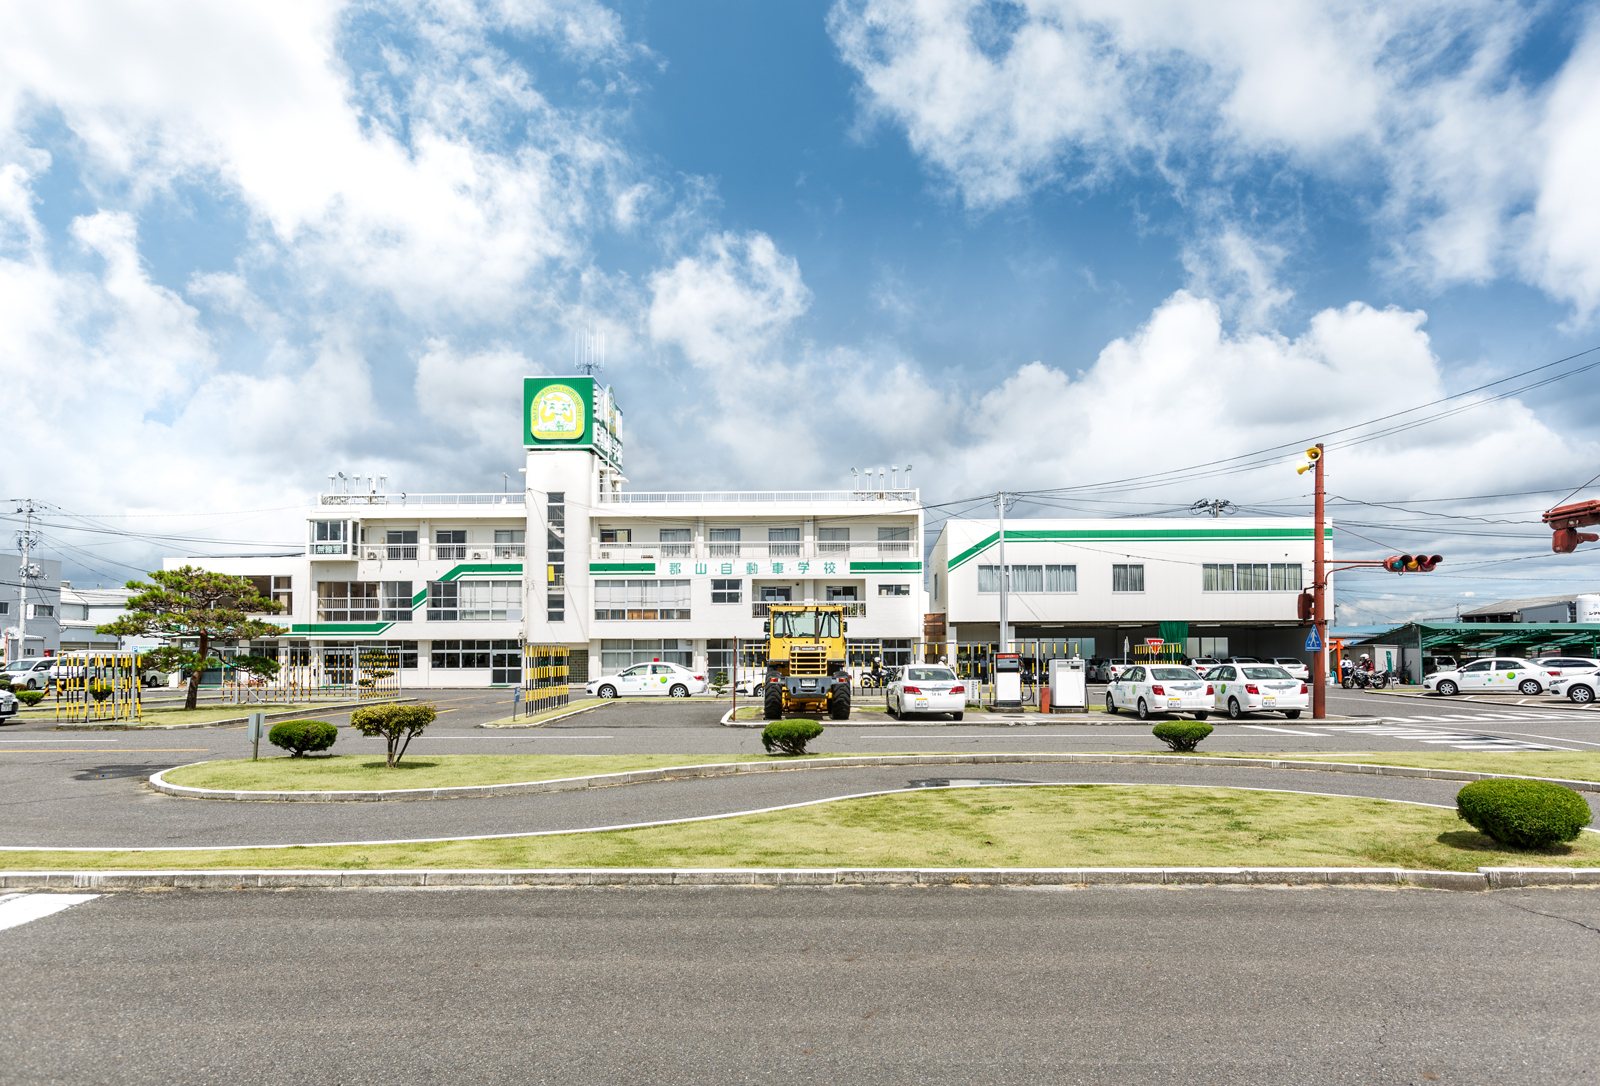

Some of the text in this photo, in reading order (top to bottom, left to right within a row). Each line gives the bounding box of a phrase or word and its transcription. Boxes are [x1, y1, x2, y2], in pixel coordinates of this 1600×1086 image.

[317, 545, 342, 554] 無線室
[669, 562, 836, 575] 郡山自動車学校
